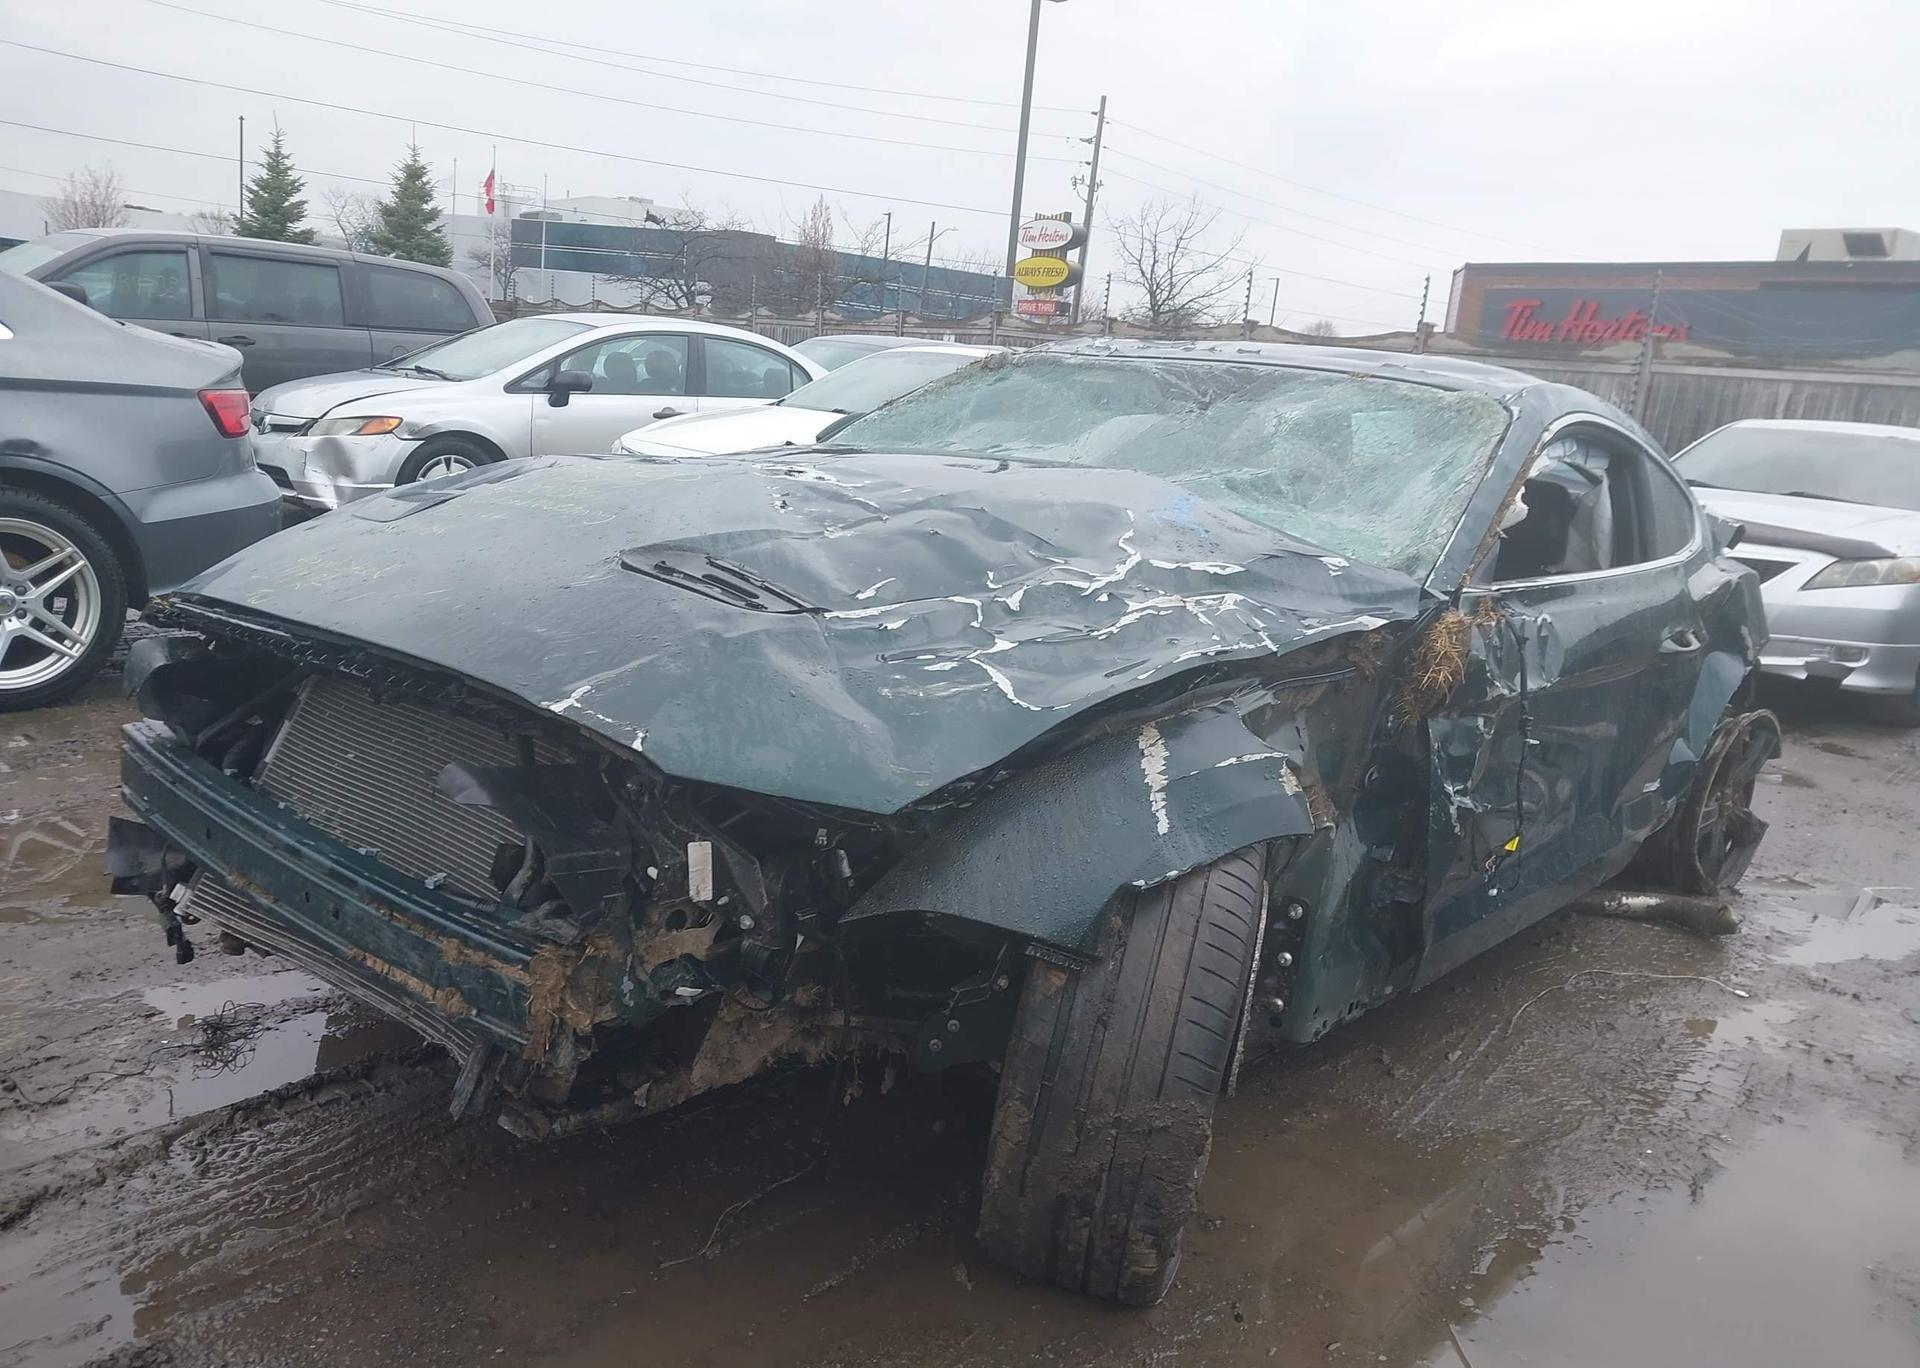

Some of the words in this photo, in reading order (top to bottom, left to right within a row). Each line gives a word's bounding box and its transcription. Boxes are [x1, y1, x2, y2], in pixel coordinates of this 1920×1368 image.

[1022, 227, 1037, 242] Tim
[1038, 226, 1068, 242] Hortons
[1017, 268, 1041, 277] ALWAYS
[1042, 268, 1064, 277] FRESH
[1018, 302, 1037, 312] DRIVE
[1037, 303, 1055, 312] THRU
[1502, 298, 1552, 341] Tim
